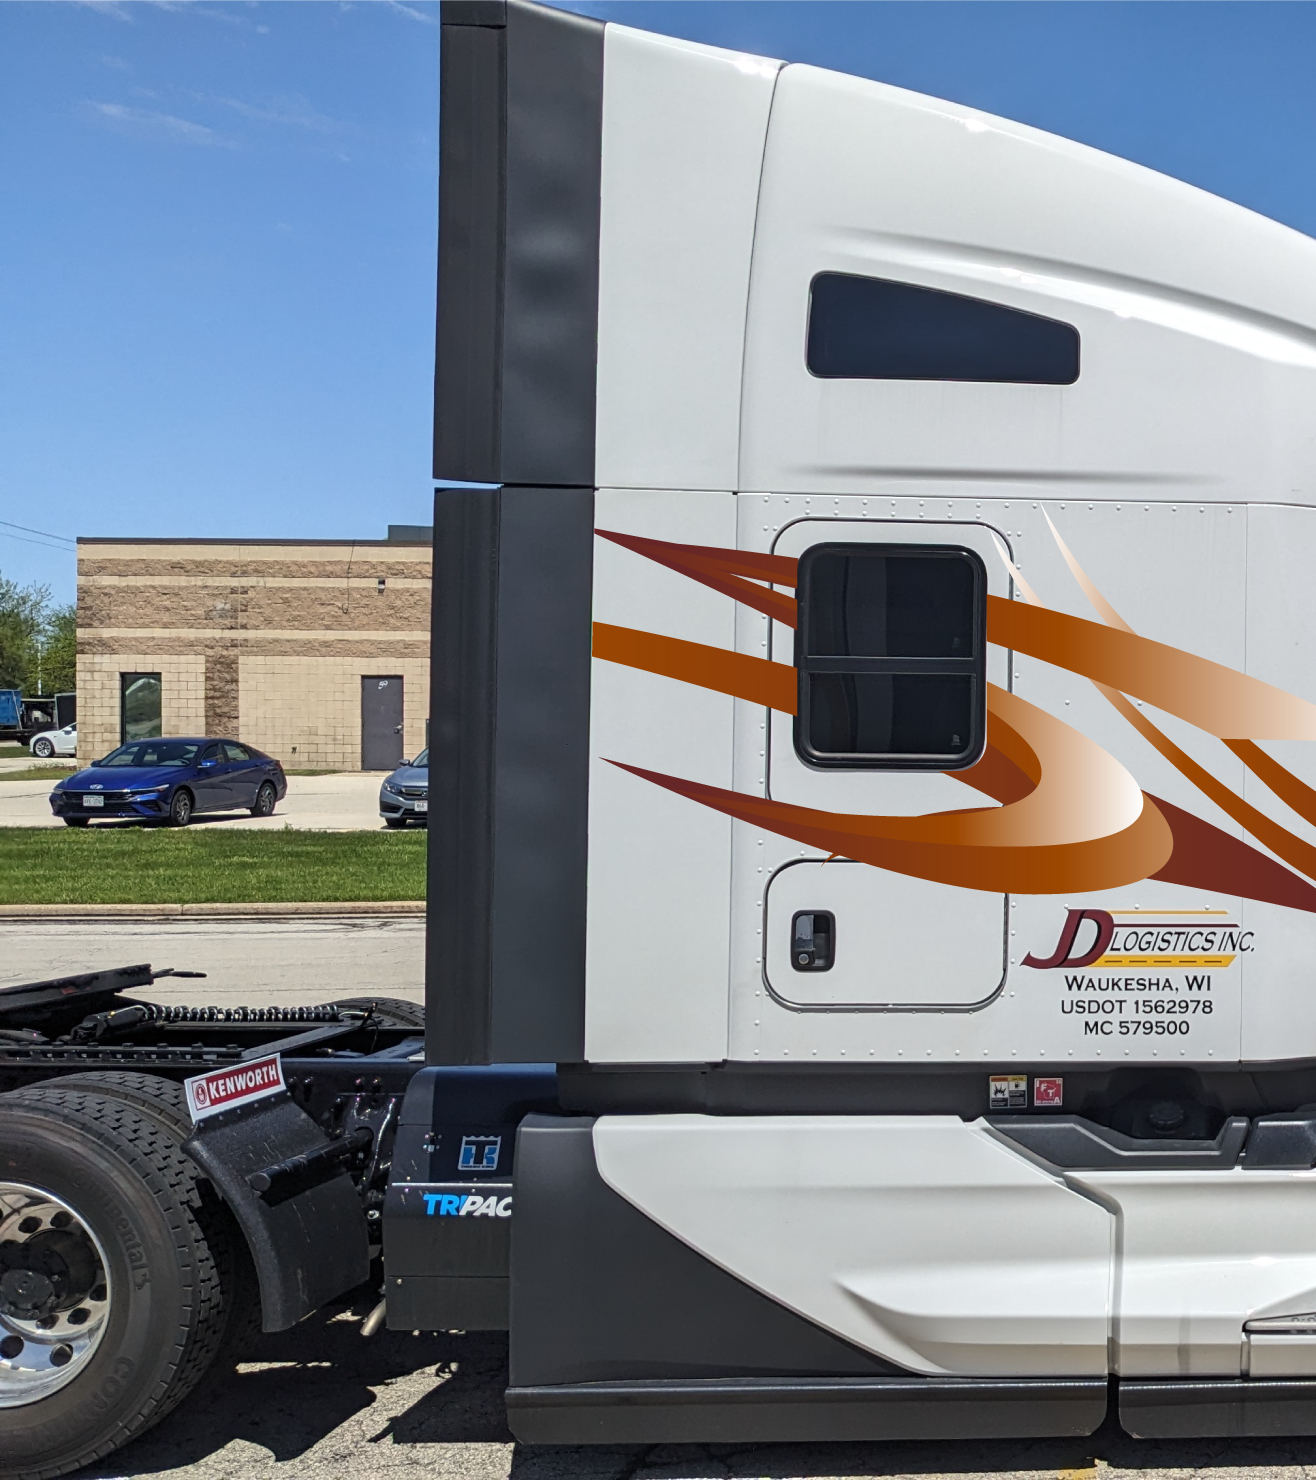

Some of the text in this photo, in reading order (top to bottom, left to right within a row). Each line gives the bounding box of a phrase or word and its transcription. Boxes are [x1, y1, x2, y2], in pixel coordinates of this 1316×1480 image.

[1110, 931, 1216, 952] LOGISTICS
[1218, 932, 1254, 951] INC.
[1185, 976, 1210, 990] WI
[1062, 1000, 1212, 1014] USDOT 1562978
[1085, 1021, 1189, 1035] MC 579500
[208, 1064, 278, 1100] KENWORTH
